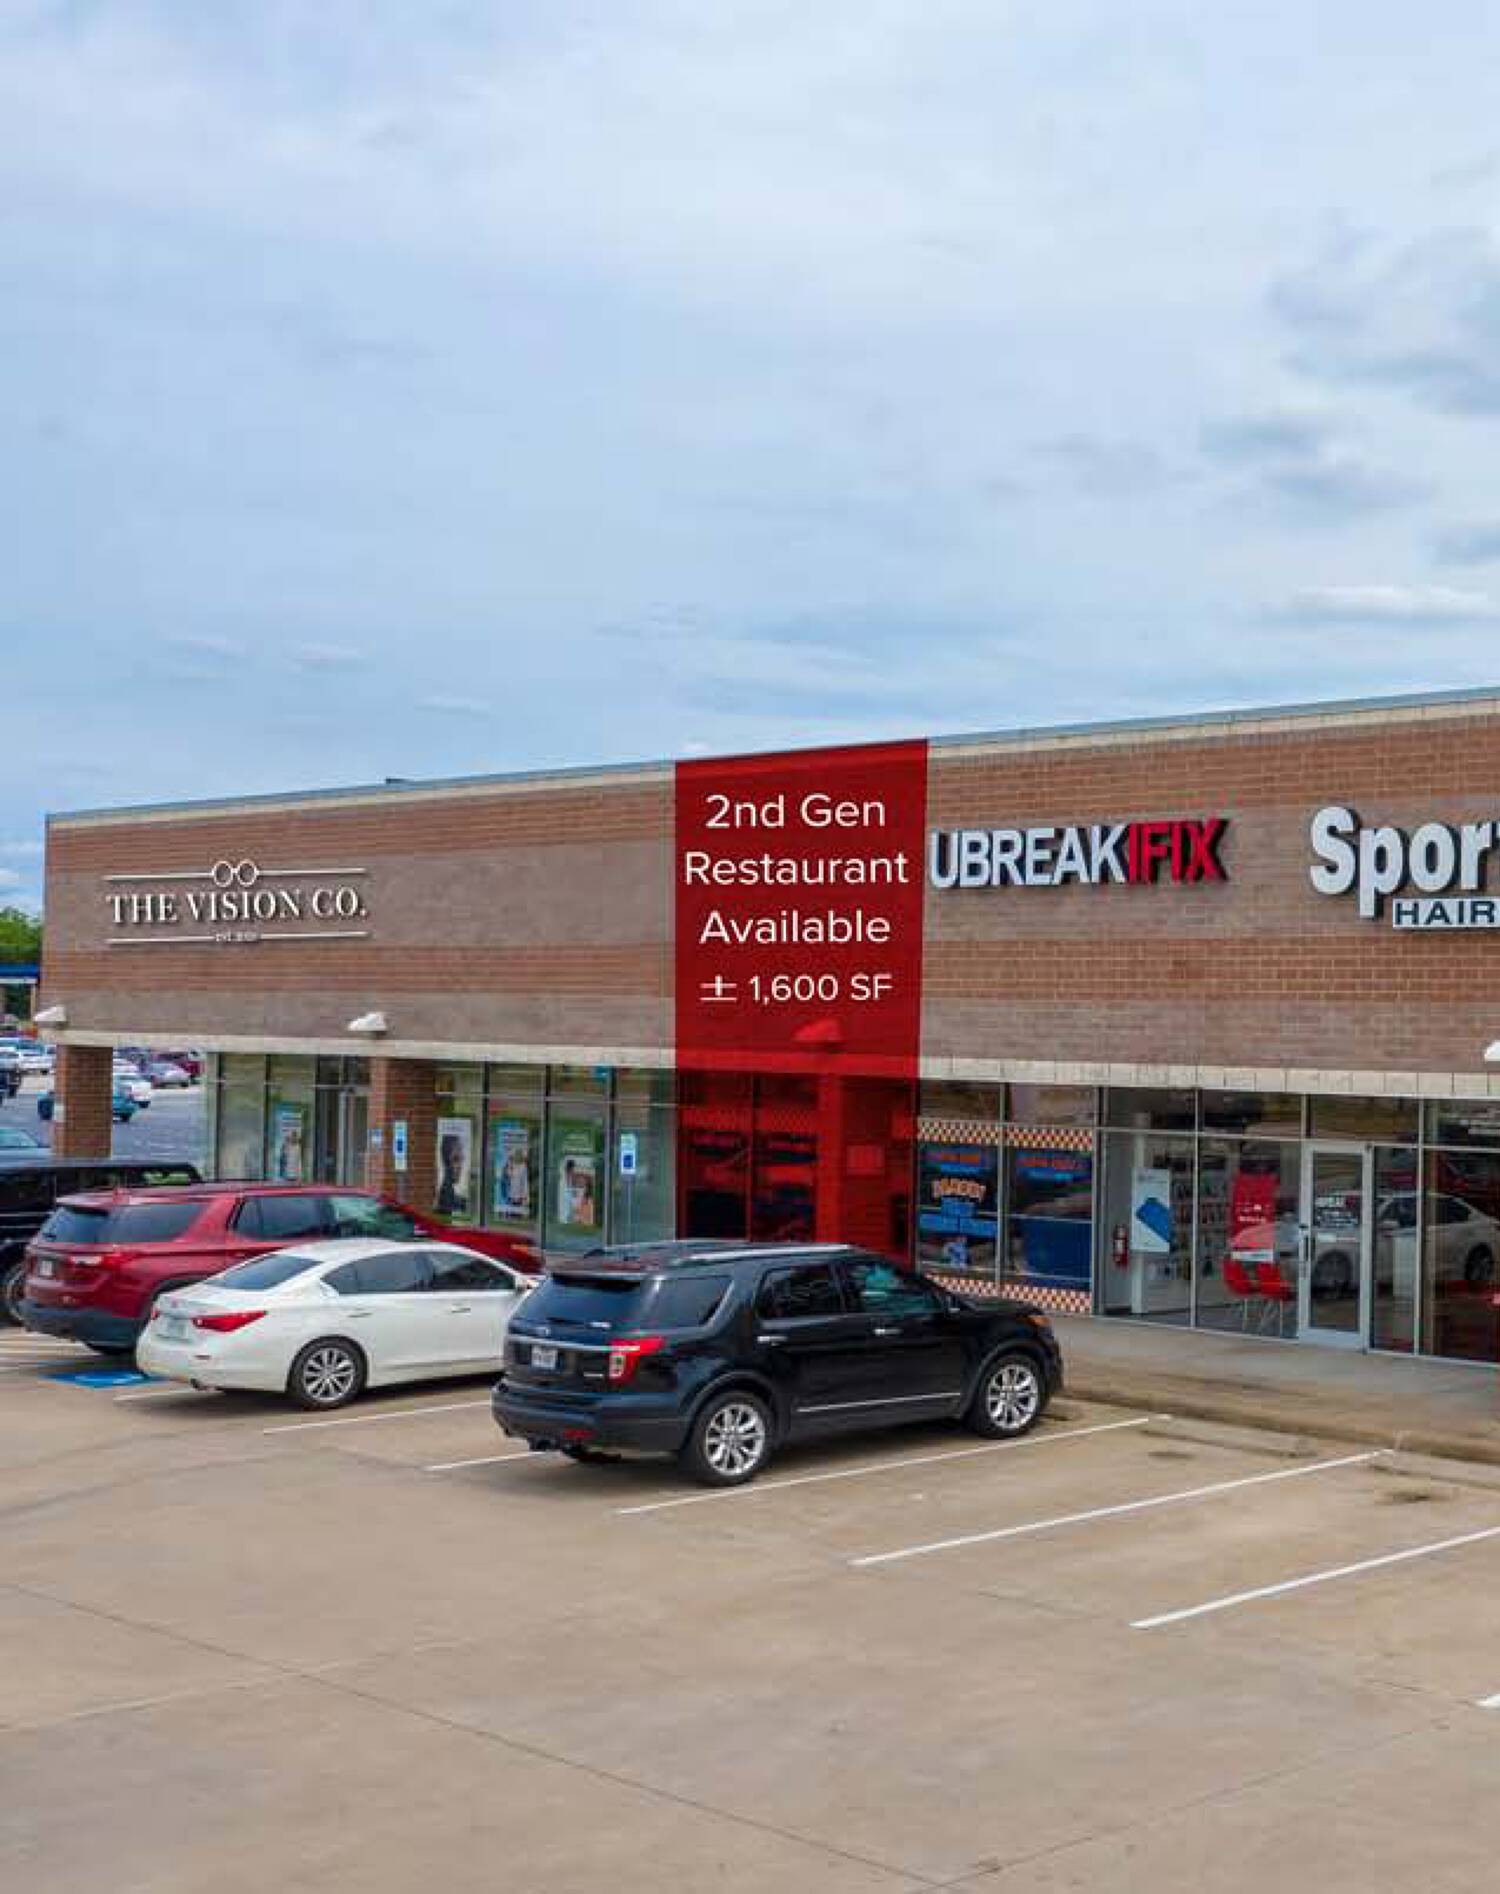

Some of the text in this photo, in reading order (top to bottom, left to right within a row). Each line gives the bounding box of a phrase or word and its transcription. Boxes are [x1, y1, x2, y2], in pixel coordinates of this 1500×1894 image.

[929, 817, 1228, 888] UBREAKIFIX
[105, 886, 368, 923] THE VISION CO.
